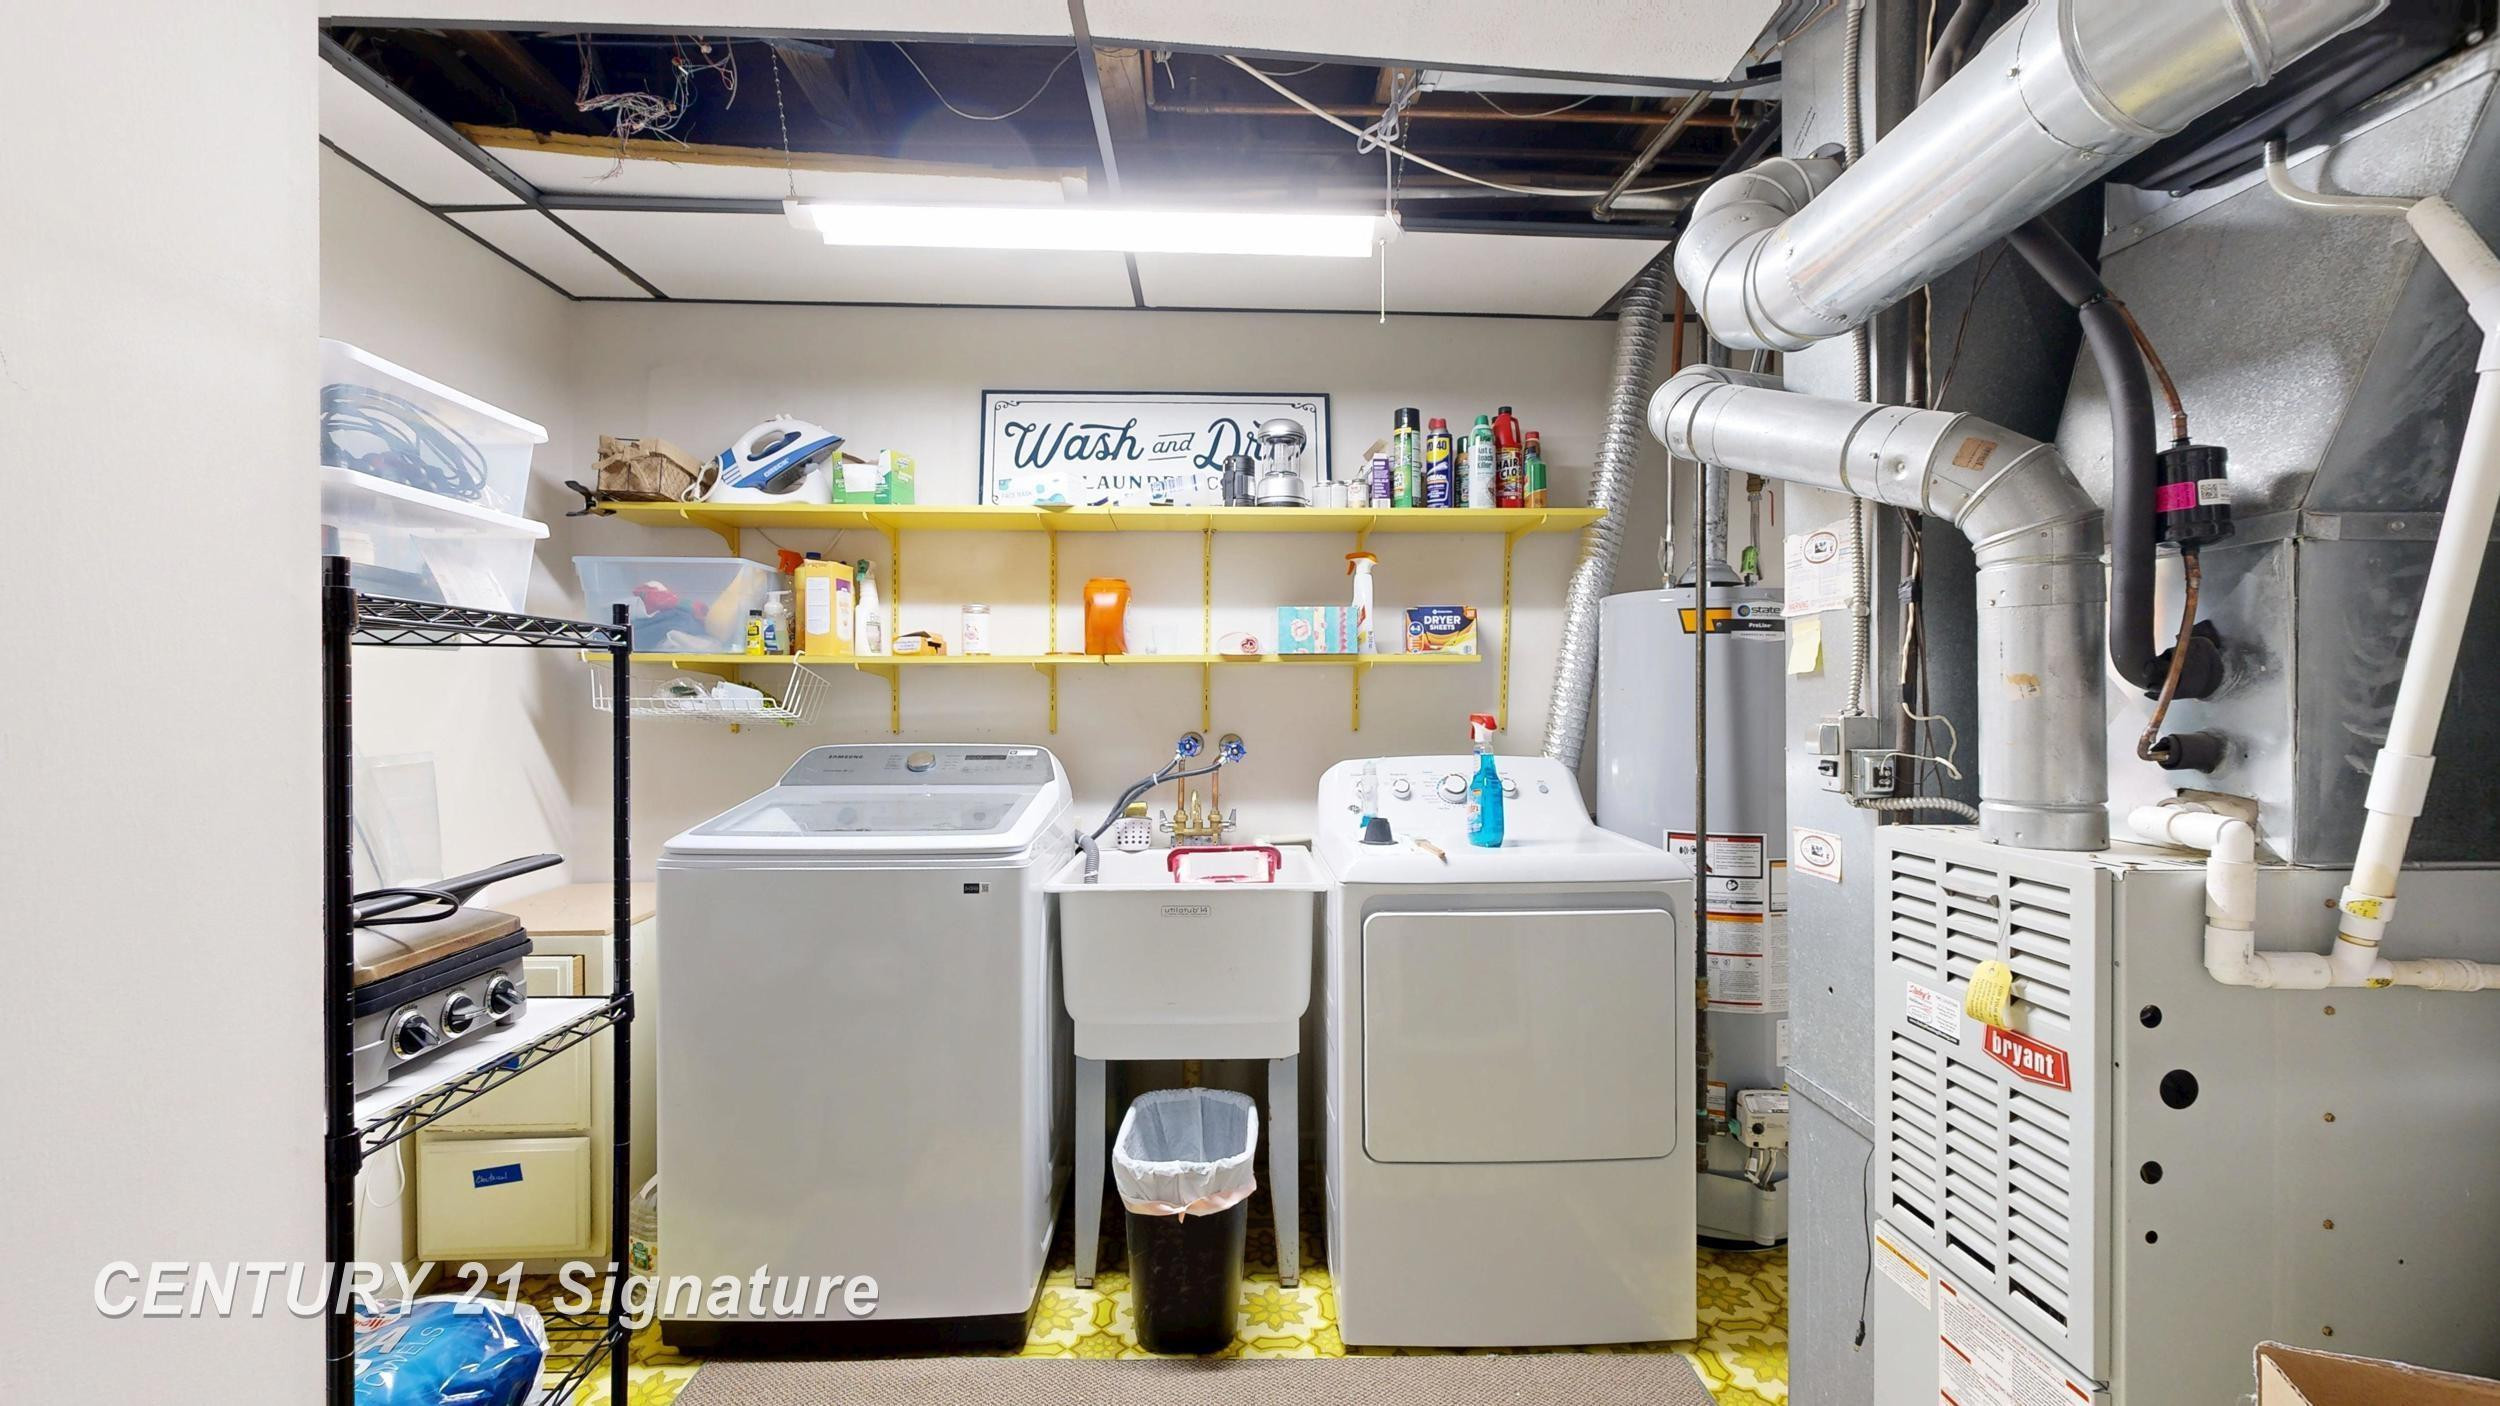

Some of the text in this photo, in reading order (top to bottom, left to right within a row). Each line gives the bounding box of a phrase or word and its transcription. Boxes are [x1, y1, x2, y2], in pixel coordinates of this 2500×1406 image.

[1005, 417, 1144, 469] Wash
[1152, 432, 1195, 454] and
[1427, 440, 1447, 451] WD40
[764, 458, 790, 478] ORECK
[1496, 458, 1519, 469] HAIR
[1751, 606, 1780, 614] state
[1424, 615, 1461, 625] DRYER
[1992, 1030, 2054, 1079] bryant
